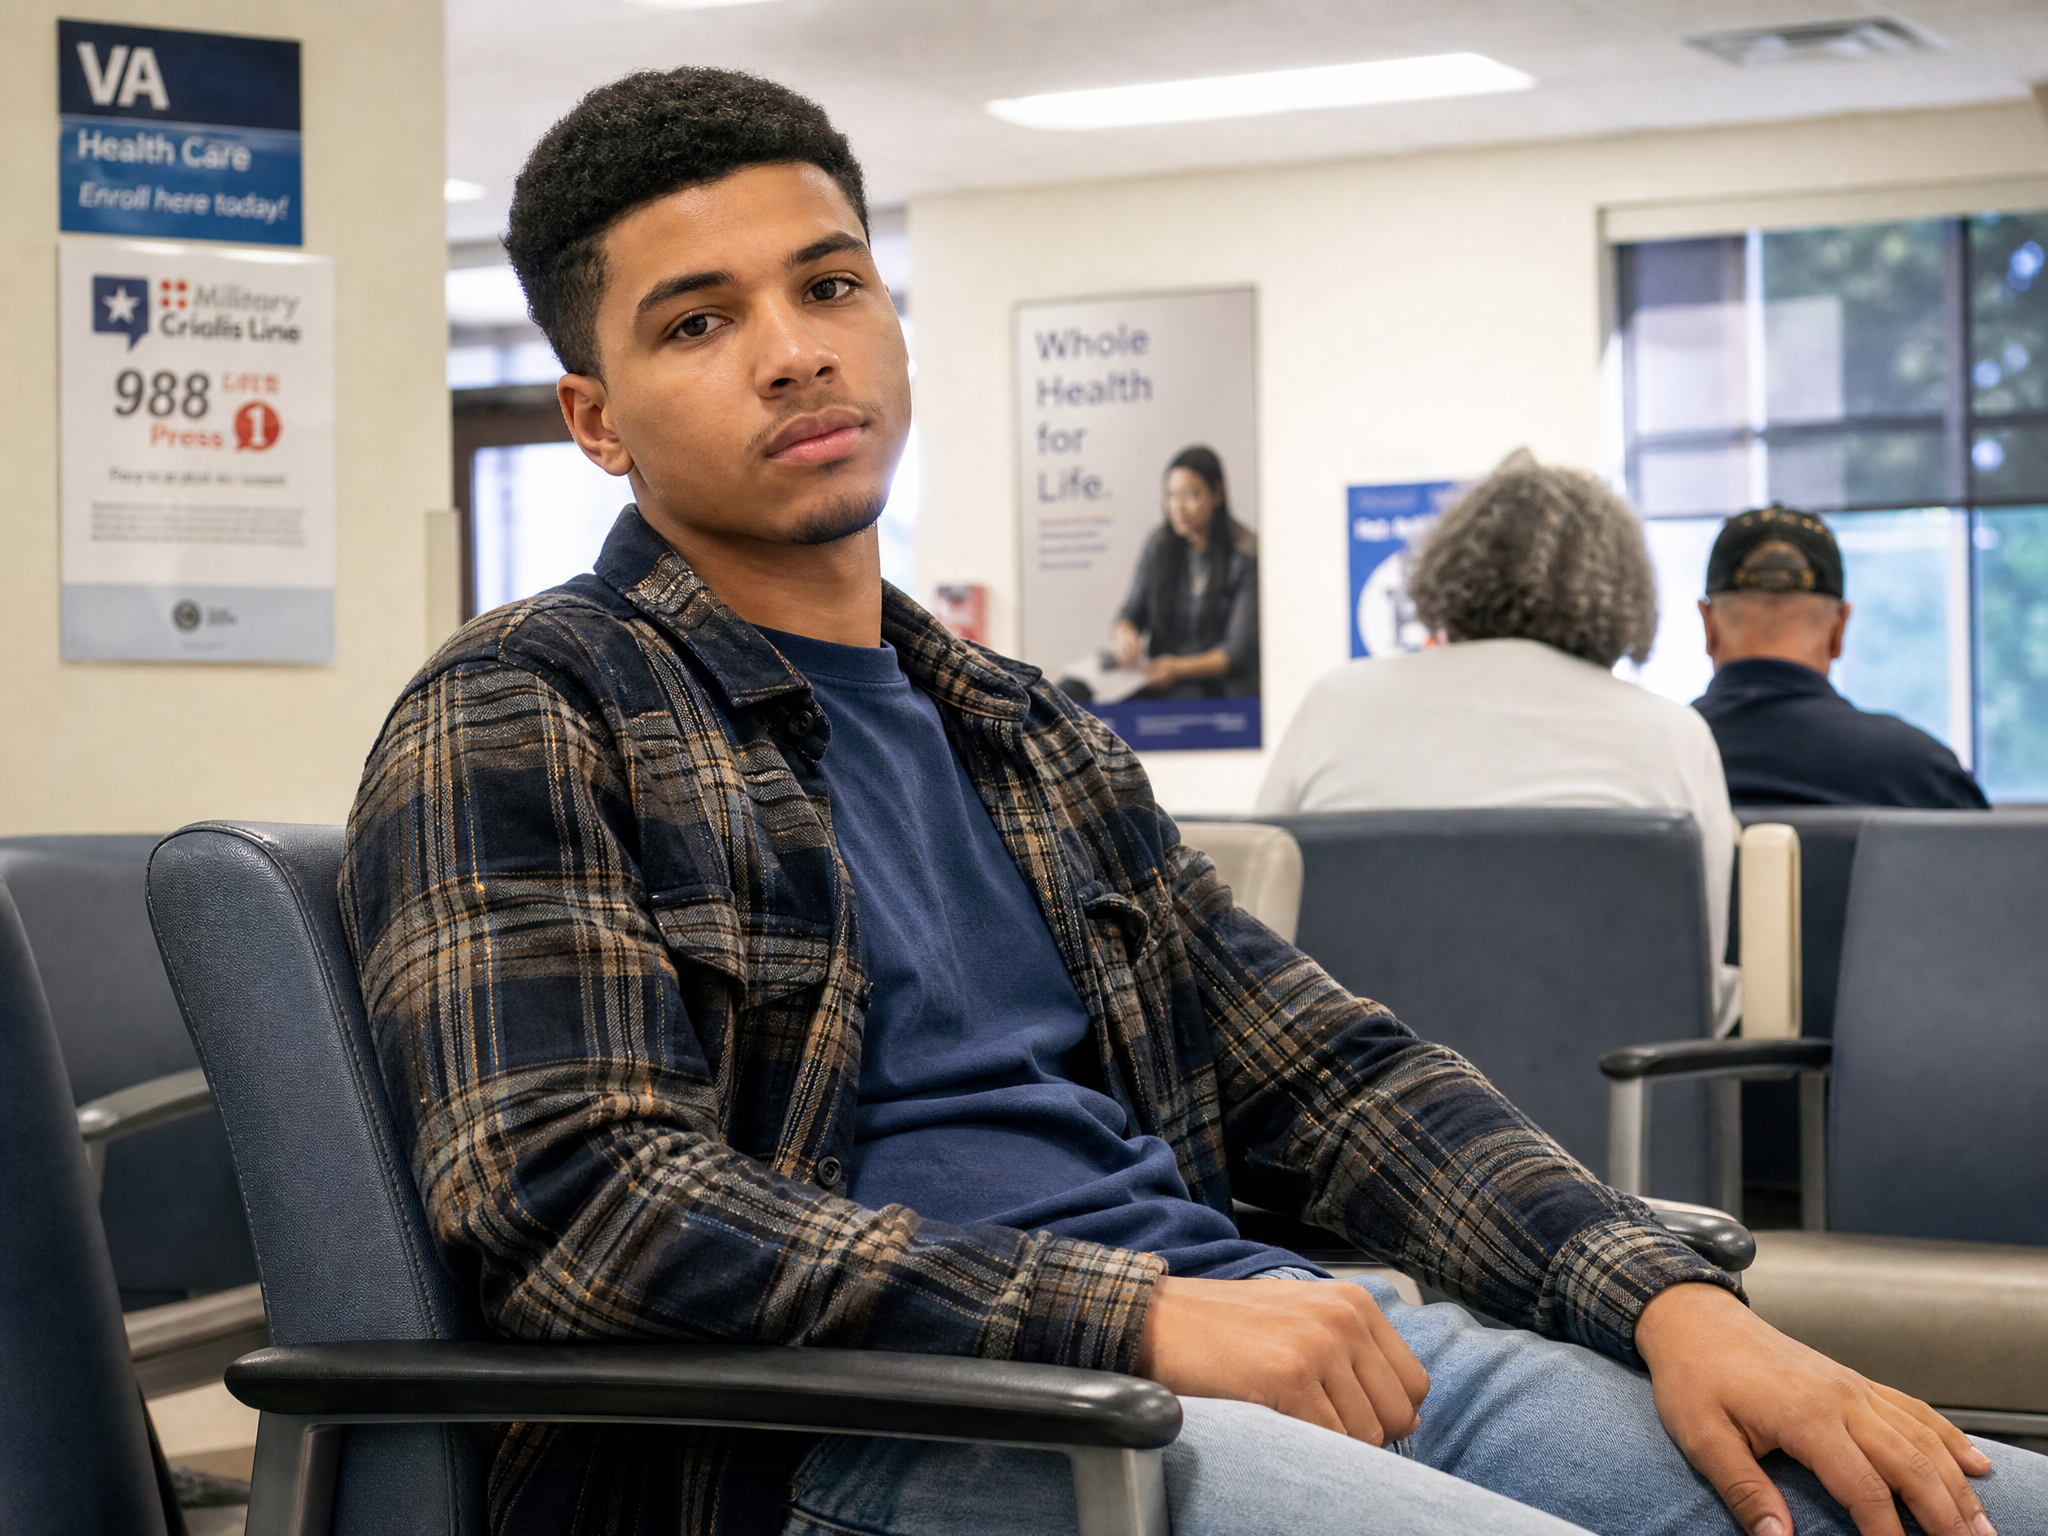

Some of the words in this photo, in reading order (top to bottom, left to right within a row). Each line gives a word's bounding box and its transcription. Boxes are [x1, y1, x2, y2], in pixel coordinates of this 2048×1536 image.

[76, 41, 170, 110] VA
[78, 128, 176, 166] Health
[181, 136, 253, 172] Care
[78, 180, 151, 211] Enroll
[154, 186, 211, 216] here
[214, 191, 290, 225] today!
[248, 315, 302, 344] Line
[1035, 323, 1150, 361] Whole
[114, 367, 211, 419] 988
[1036, 368, 1154, 409] Health
[150, 422, 223, 450] Press
[1037, 420, 1088, 455] for
[1037, 466, 1113, 503] Life.
